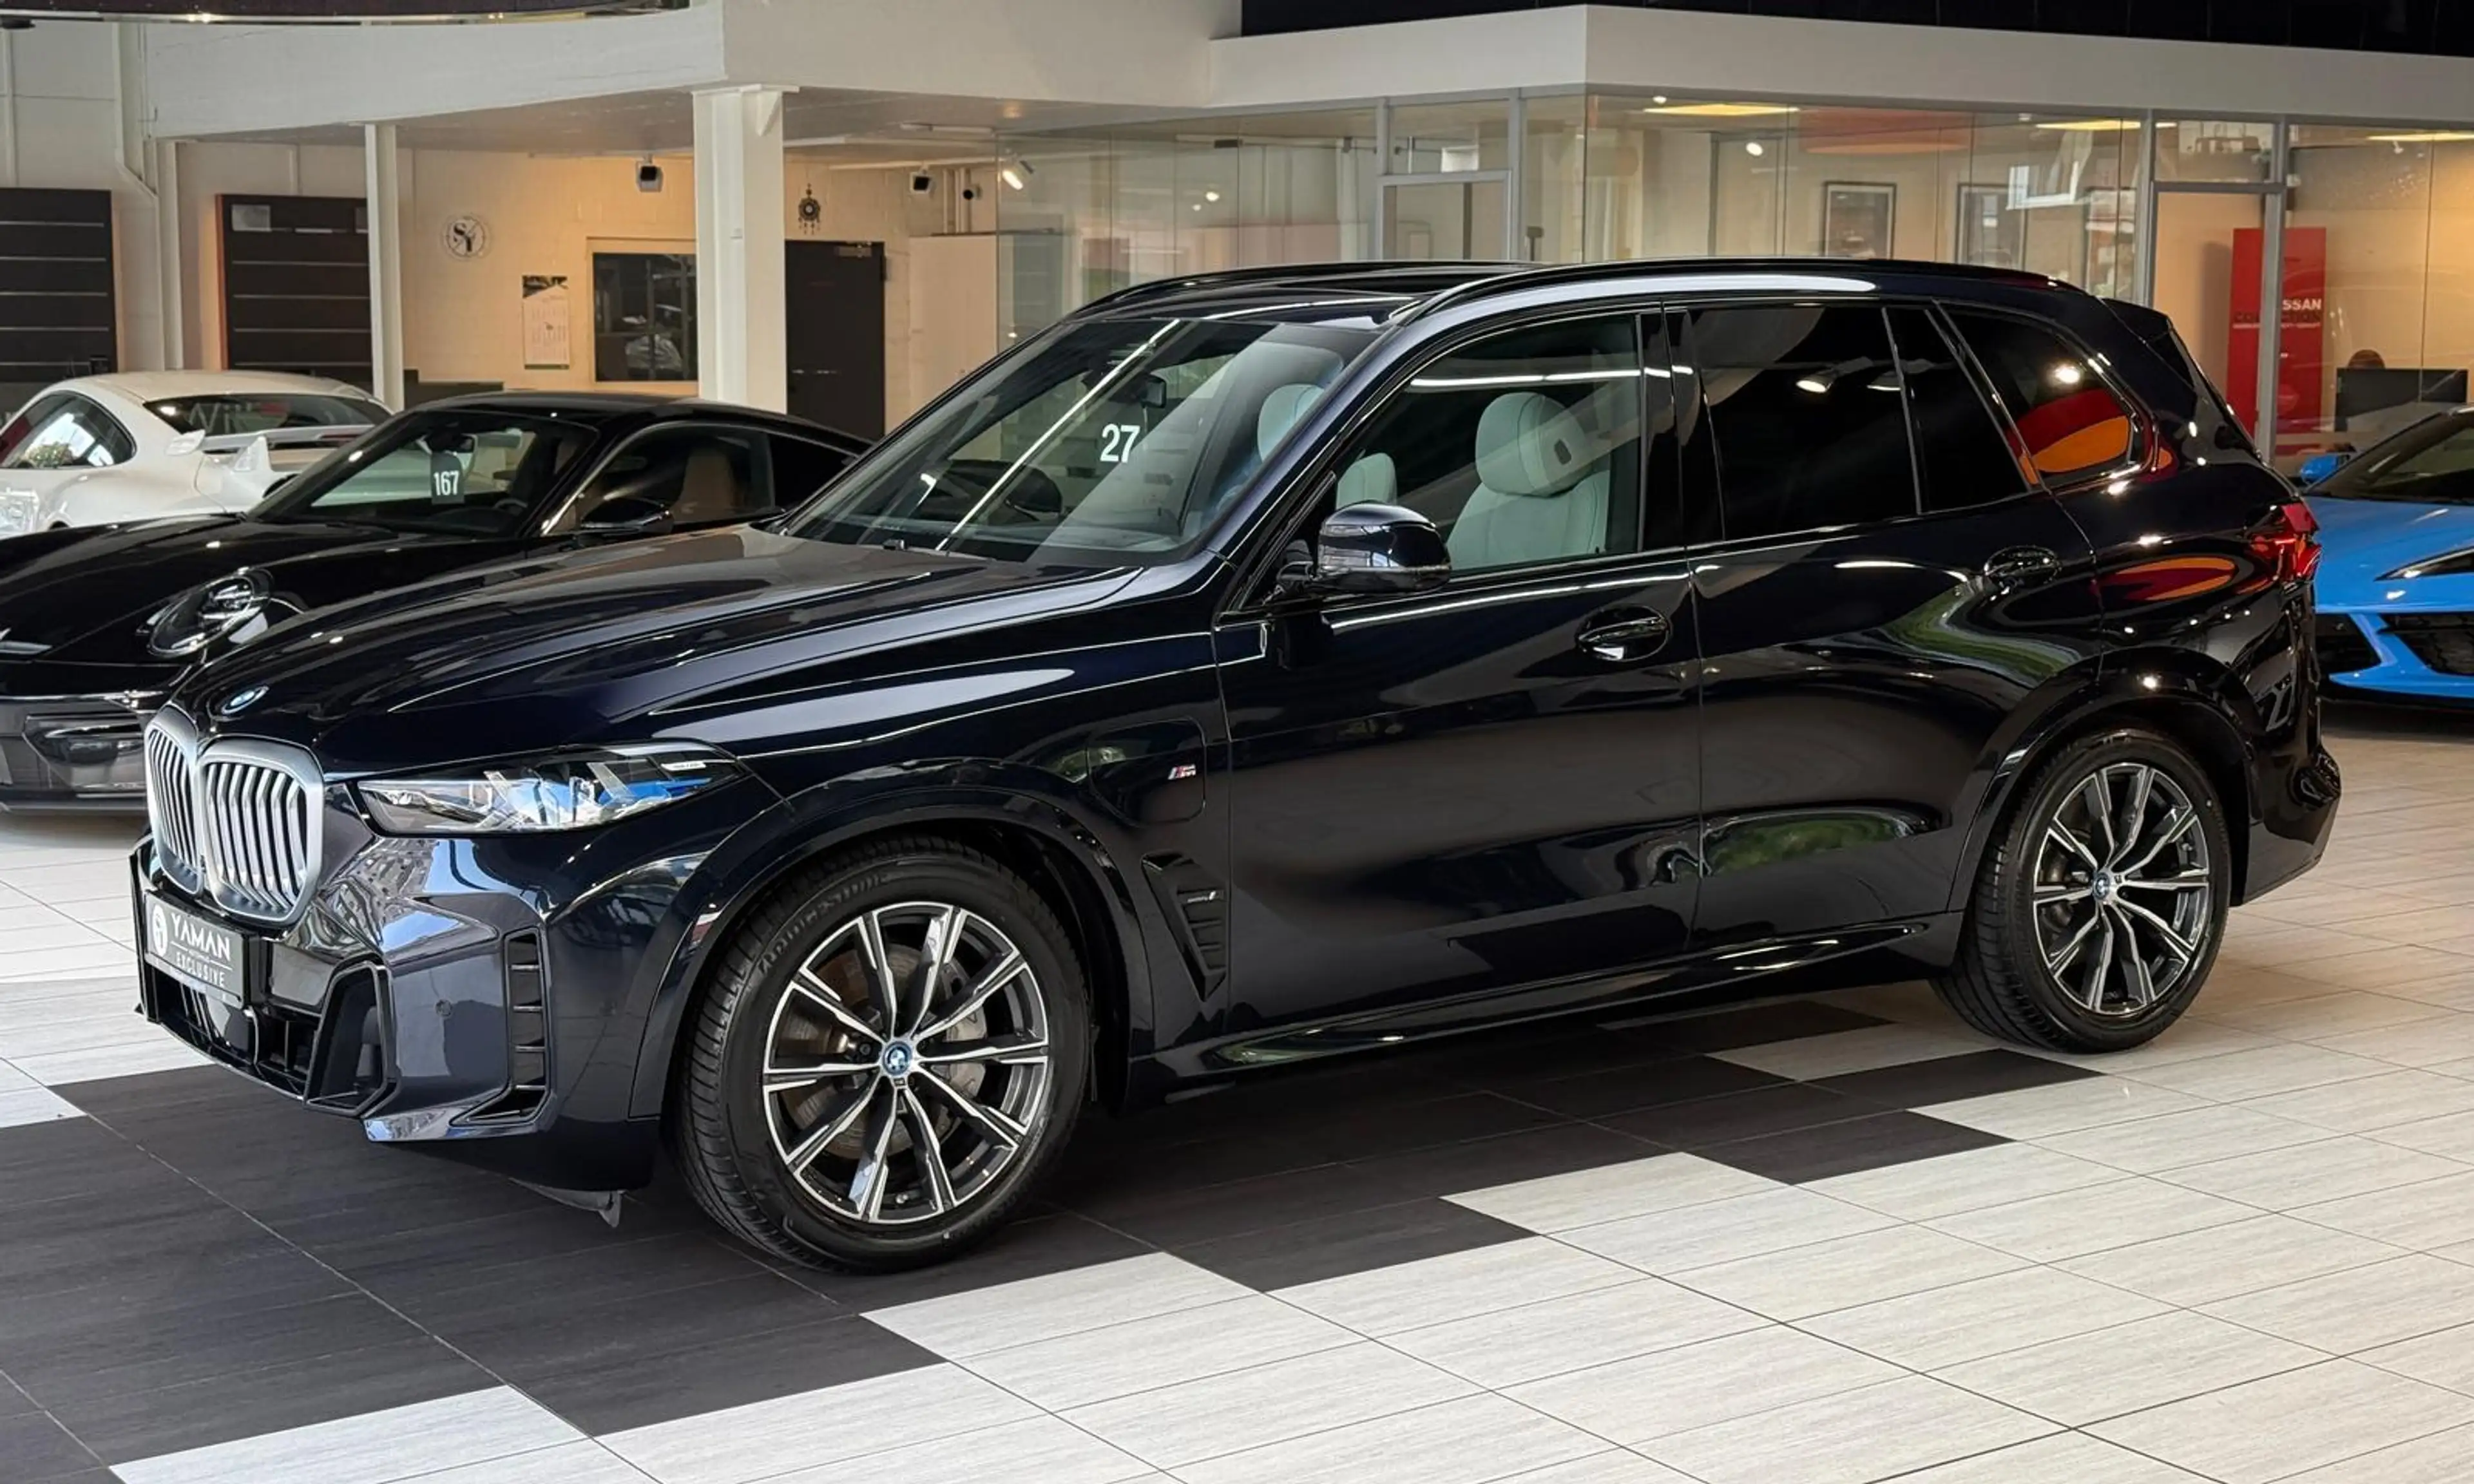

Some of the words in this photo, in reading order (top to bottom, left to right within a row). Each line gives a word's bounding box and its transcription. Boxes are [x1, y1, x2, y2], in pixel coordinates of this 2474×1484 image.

[2282, 298, 2322, 310] SSAN
[1100, 423, 1140, 463] 27
[433, 470, 459, 495] 167
[171, 912, 231, 962] YAMAN
[176, 951, 225, 988] EXCLUSIVE
